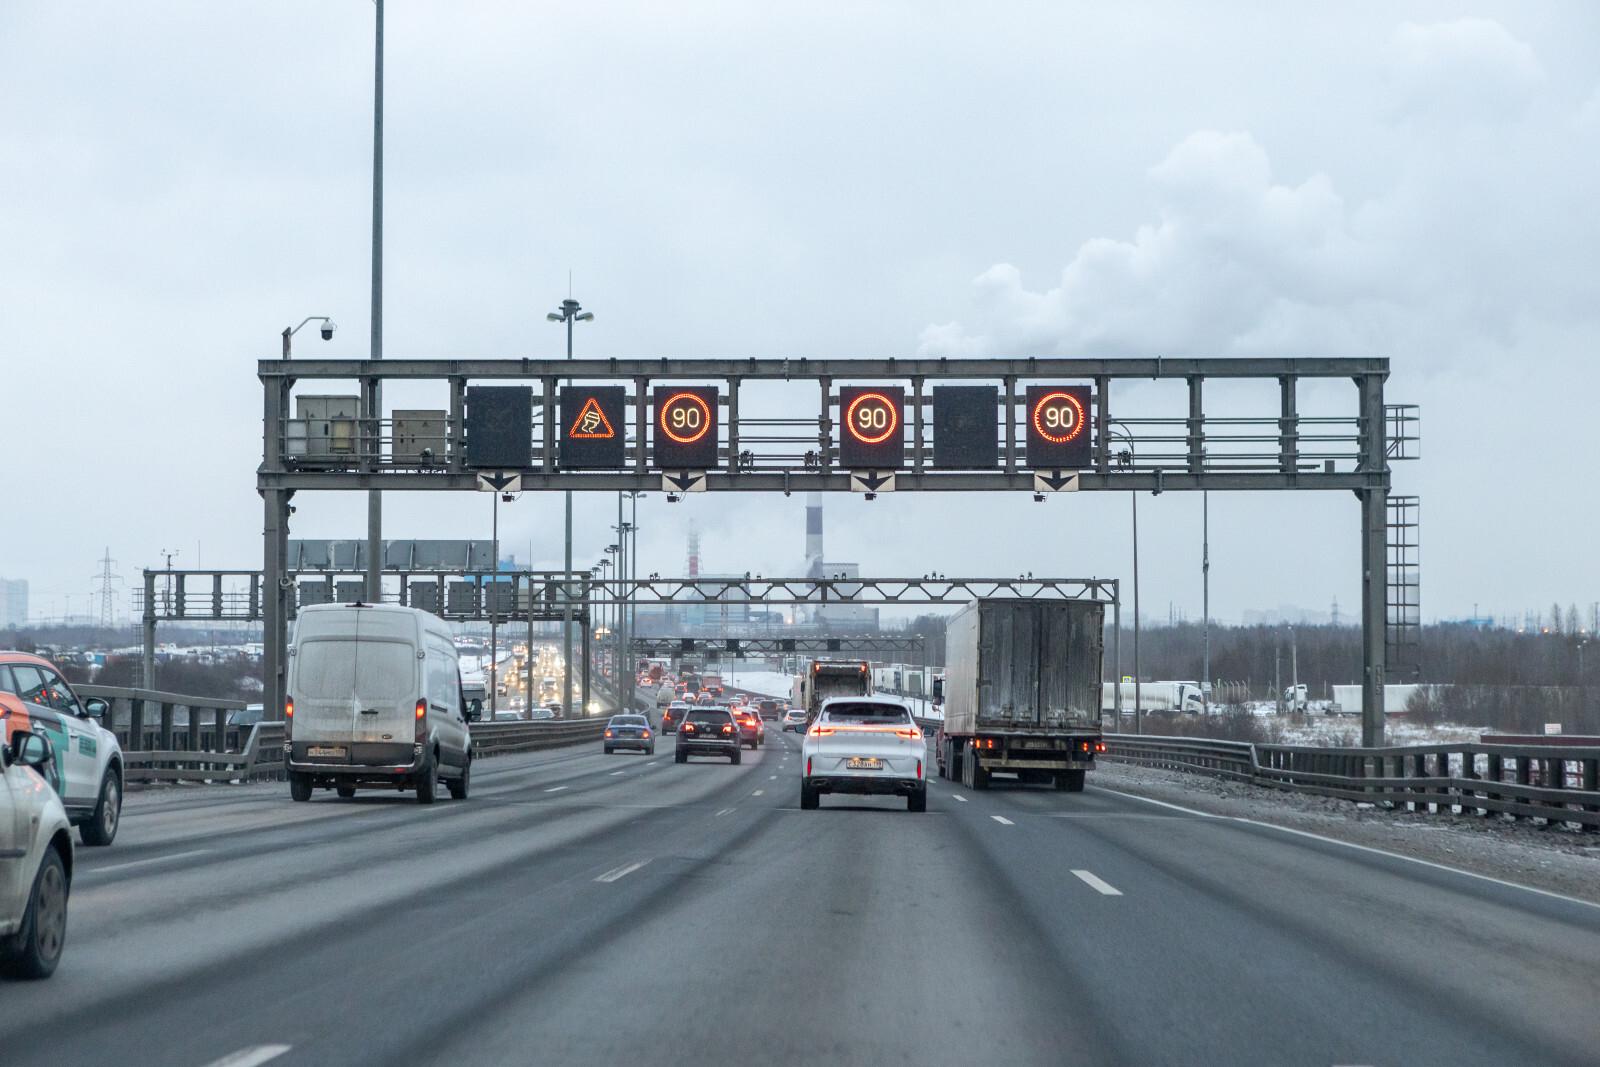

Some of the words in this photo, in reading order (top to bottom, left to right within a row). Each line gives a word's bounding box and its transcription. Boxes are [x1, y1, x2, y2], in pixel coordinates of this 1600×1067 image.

[673, 408, 699, 428] 90
[859, 408, 886, 428] 90
[1046, 407, 1073, 428] 90
